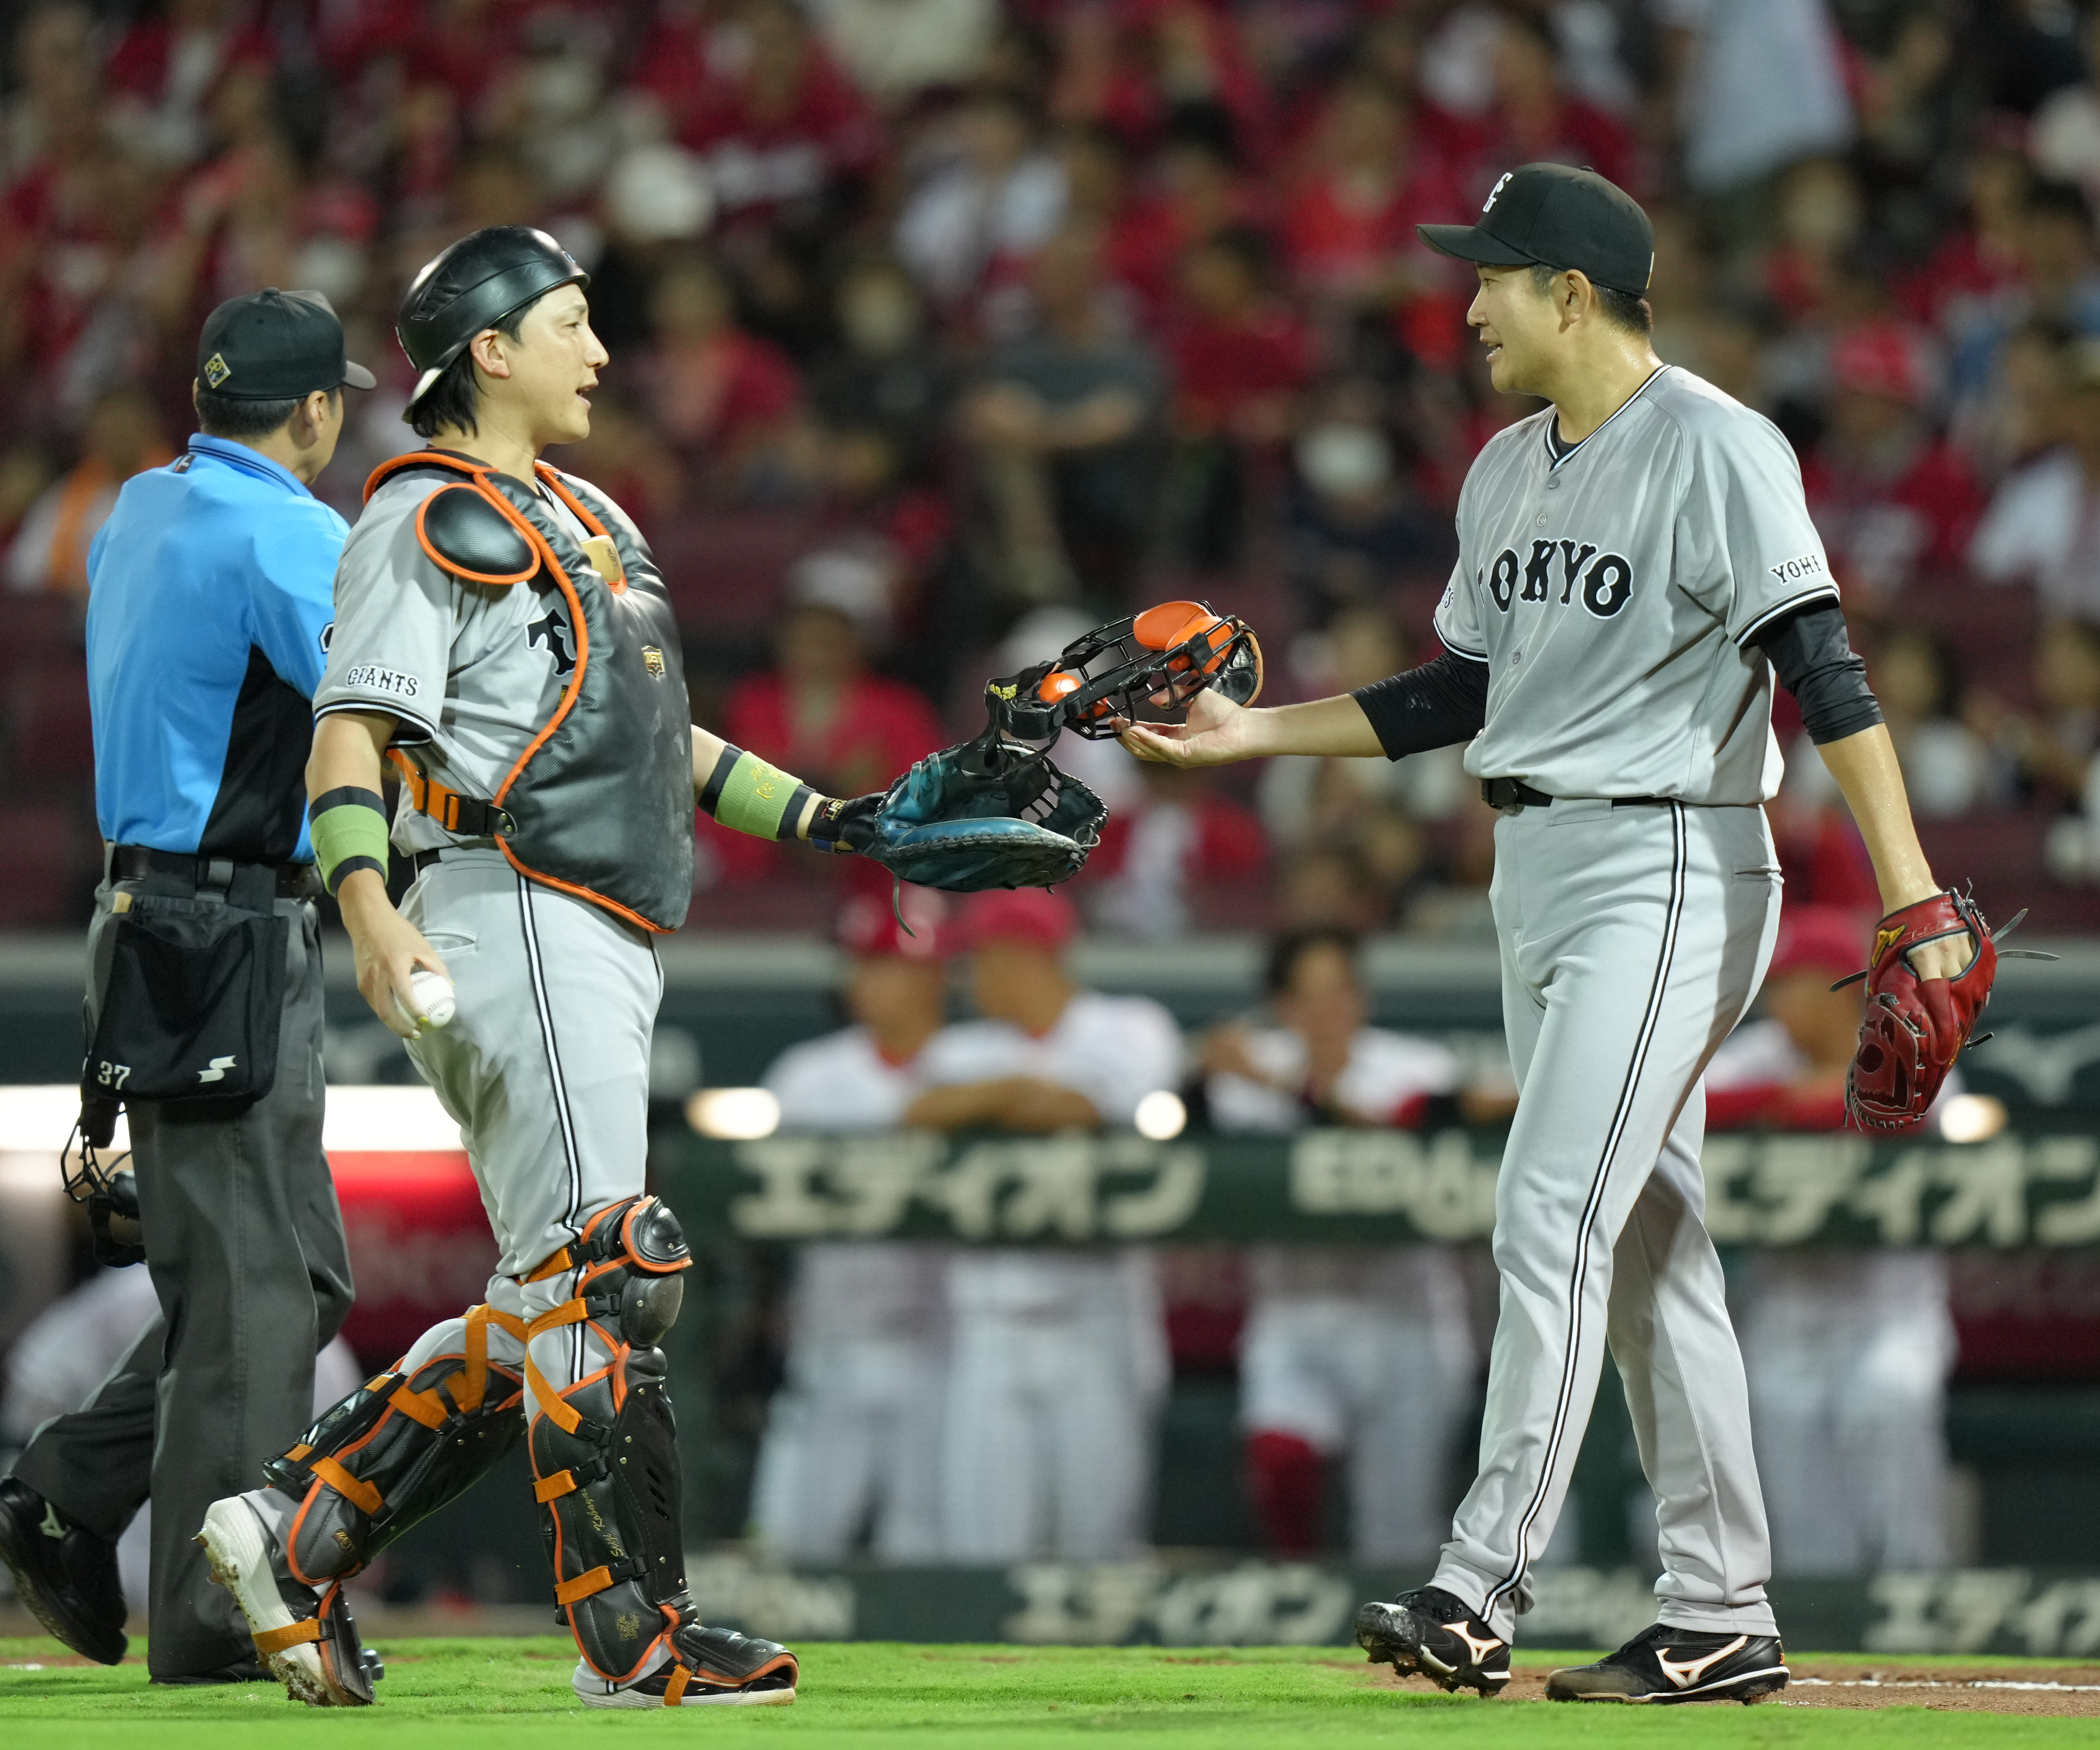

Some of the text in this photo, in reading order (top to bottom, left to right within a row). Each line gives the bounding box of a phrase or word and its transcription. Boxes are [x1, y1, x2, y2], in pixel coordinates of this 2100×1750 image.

[1477, 538, 1633, 619] OKYO
[347, 667, 418, 697] GIANTS
[97, 1060, 131, 1091] 37
[732, 1132, 1204, 1238] エディオン
